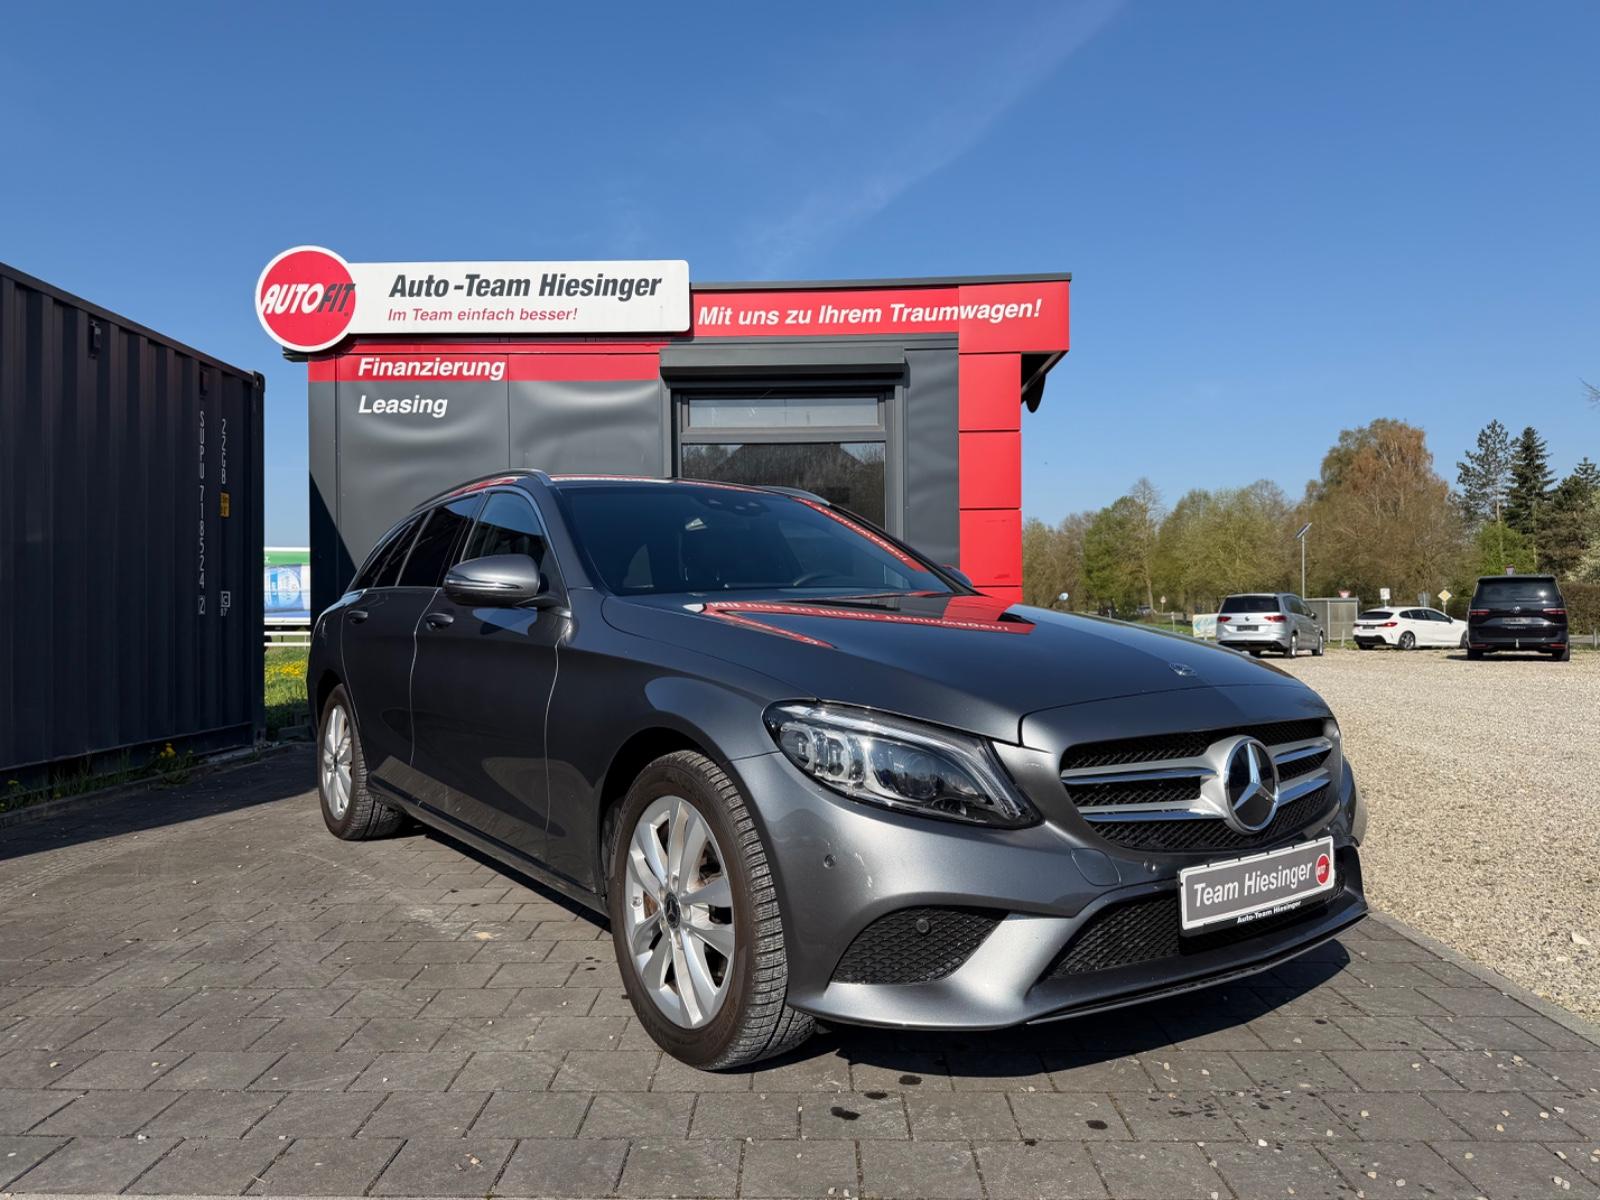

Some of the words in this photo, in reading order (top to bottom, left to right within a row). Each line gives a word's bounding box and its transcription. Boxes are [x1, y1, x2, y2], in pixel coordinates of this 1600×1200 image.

[260, 283, 356, 314] AUTOFIT
[538, 273, 663, 301] Hiesinger
[387, 309, 406, 321] Im
[411, 308, 454, 321] Team
[457, 307, 515, 321] einfach
[519, 307, 578, 321] besser!
[698, 306, 732, 326] Mit
[738, 308, 780, 325] uns
[785, 307, 812, 324] zu
[818, 304, 882, 324] Ihrem
[890, 298, 1043, 323] Traumwagen!
[358, 357, 506, 380] Finanzierung
[358, 395, 448, 418] Leasing
[1193, 881, 1240, 907] Team
[1244, 862, 1313, 896] Hiesinger
